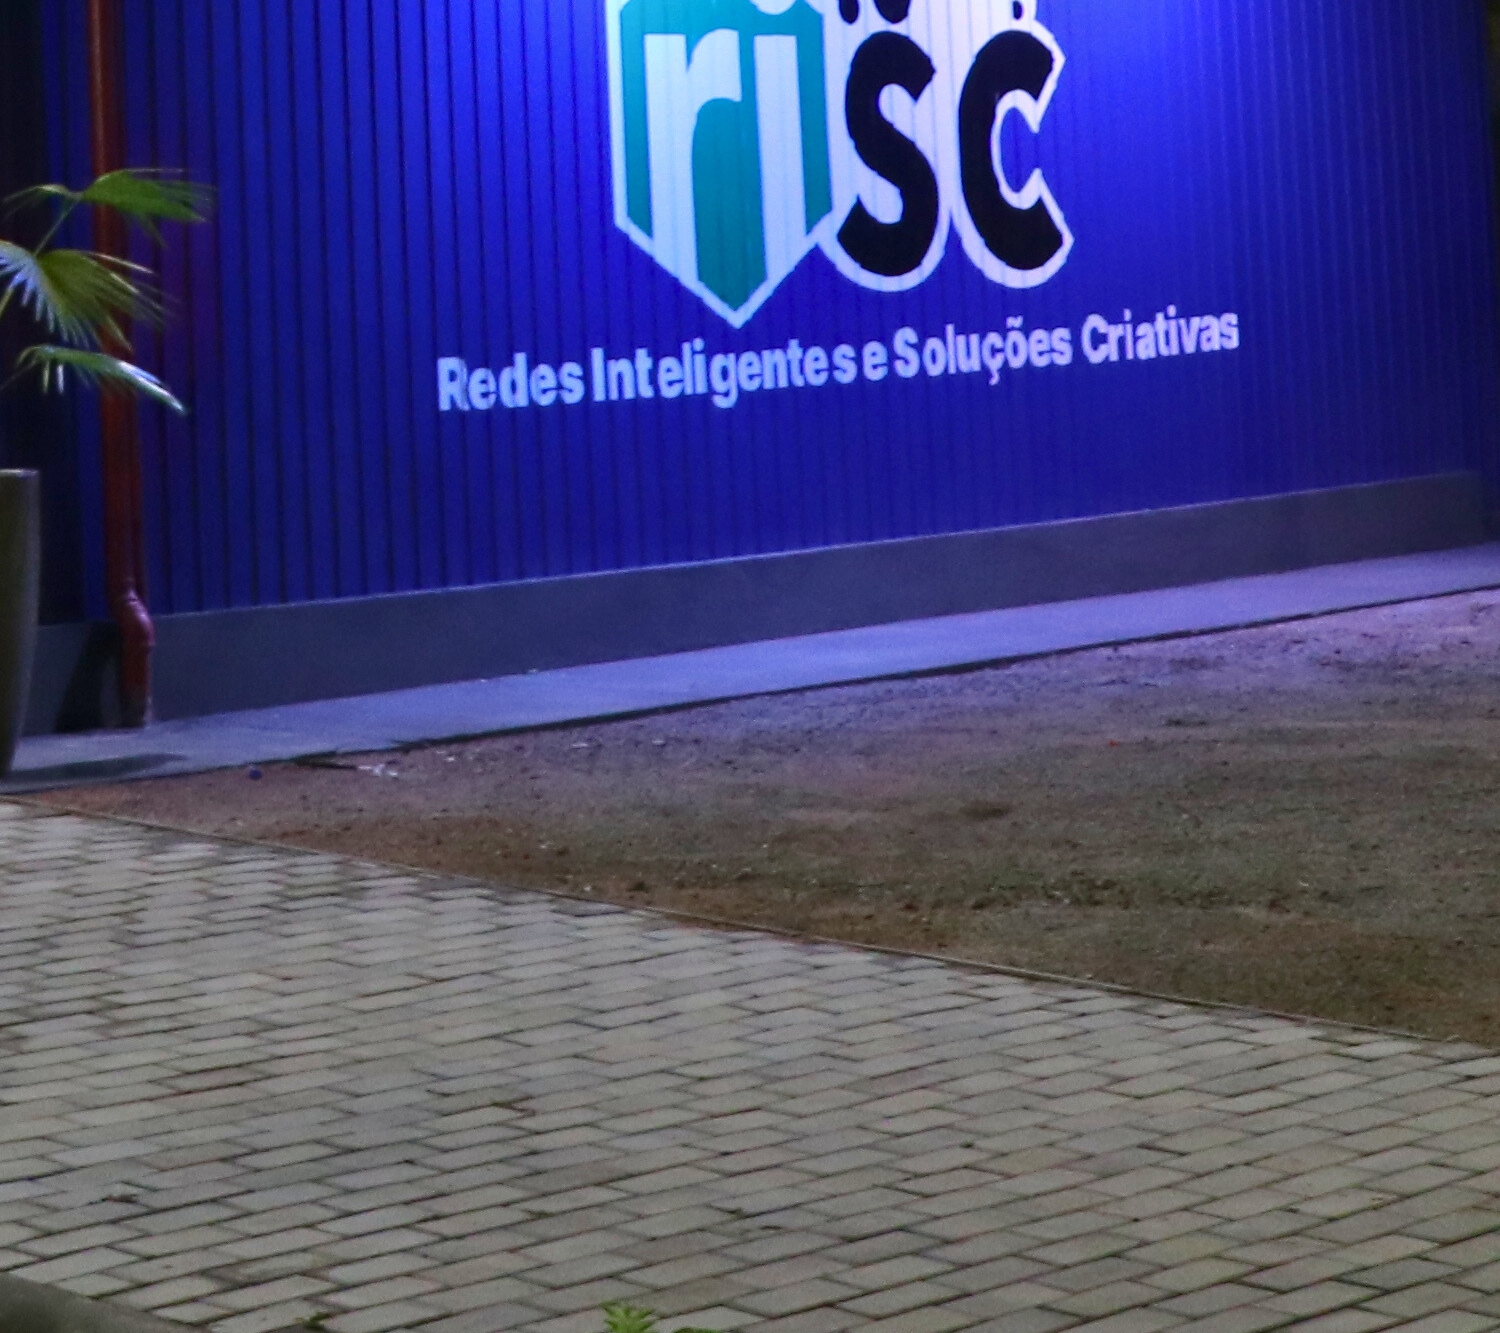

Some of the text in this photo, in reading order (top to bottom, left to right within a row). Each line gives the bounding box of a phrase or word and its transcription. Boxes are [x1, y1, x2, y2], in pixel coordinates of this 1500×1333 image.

[436, 303, 1240, 412] Redes Inteligentes e Soluções Criativas
